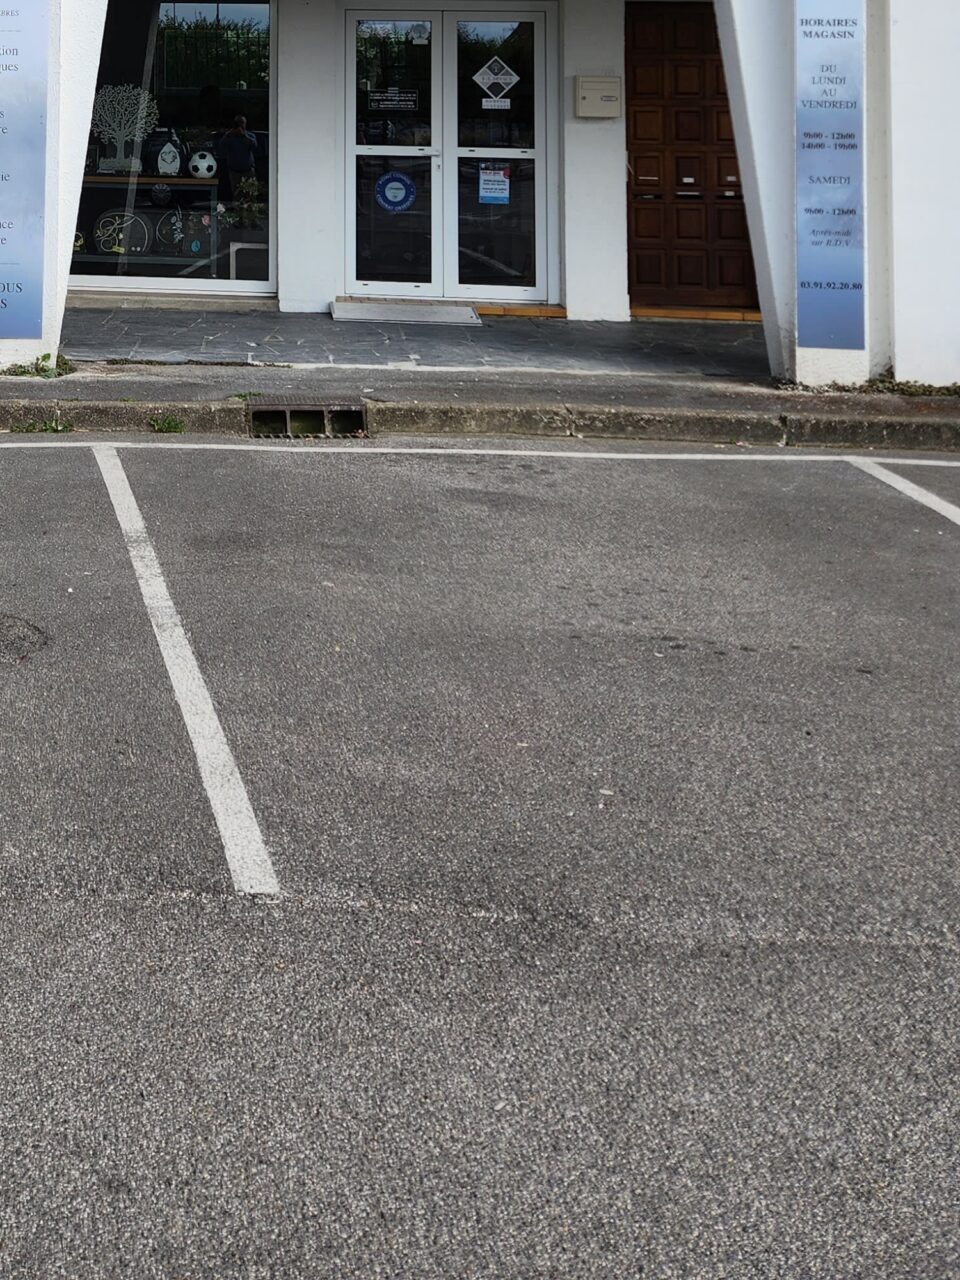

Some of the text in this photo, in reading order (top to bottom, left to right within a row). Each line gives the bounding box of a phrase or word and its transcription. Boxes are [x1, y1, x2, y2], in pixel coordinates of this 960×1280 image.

[800, 18, 858, 27] HORAIRES
[802, 30, 855, 39] MAGASIN
[821, 64, 837, 73] DU
[812, 76, 846, 85] LUNDI
[821, 88, 837, 97] AU
[801, 100, 857, 109] VENDREDI
[803, 131, 823, 140] 9h00
[831, 131, 856, 140] 12h00
[801, 142, 825, 150] 14h00
[808, 176, 851, 185] SAMEDI
[804, 207, 824, 215] 9h00
[832, 207, 856, 216] 12h00
[800, 281, 863, 291] 03.91.92.20.80
